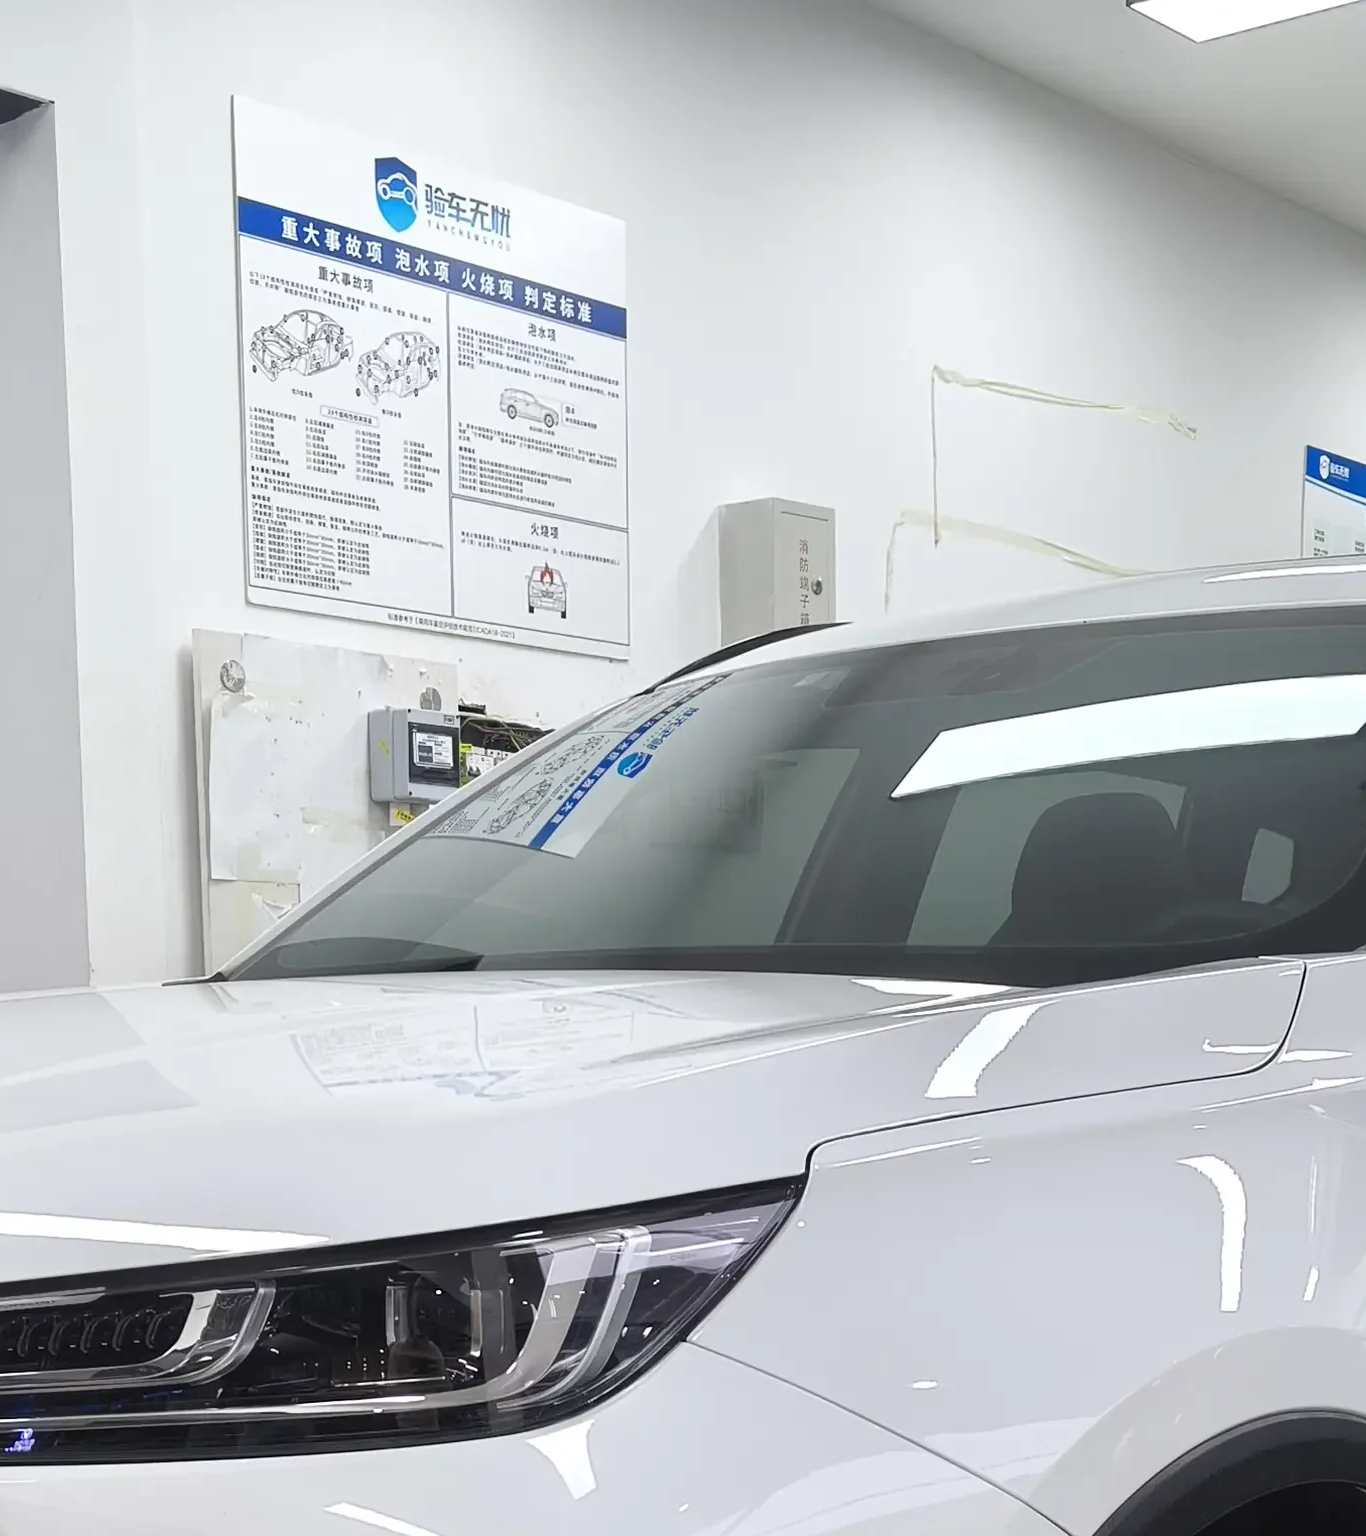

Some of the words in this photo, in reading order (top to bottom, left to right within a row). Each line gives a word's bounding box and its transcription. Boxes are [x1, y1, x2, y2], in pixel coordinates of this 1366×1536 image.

[425, 184, 511, 238] 验车无忧
[280, 215, 384, 265] 重大事故项
[395, 248, 451, 283] 泡水项
[461, 268, 515, 303] 火烧项
[524, 285, 594, 324] 判定标准
[318, 265, 375, 294] 重大事故项
[527, 322, 557, 343] 泡水项
[530, 521, 560, 540] 火烧项
